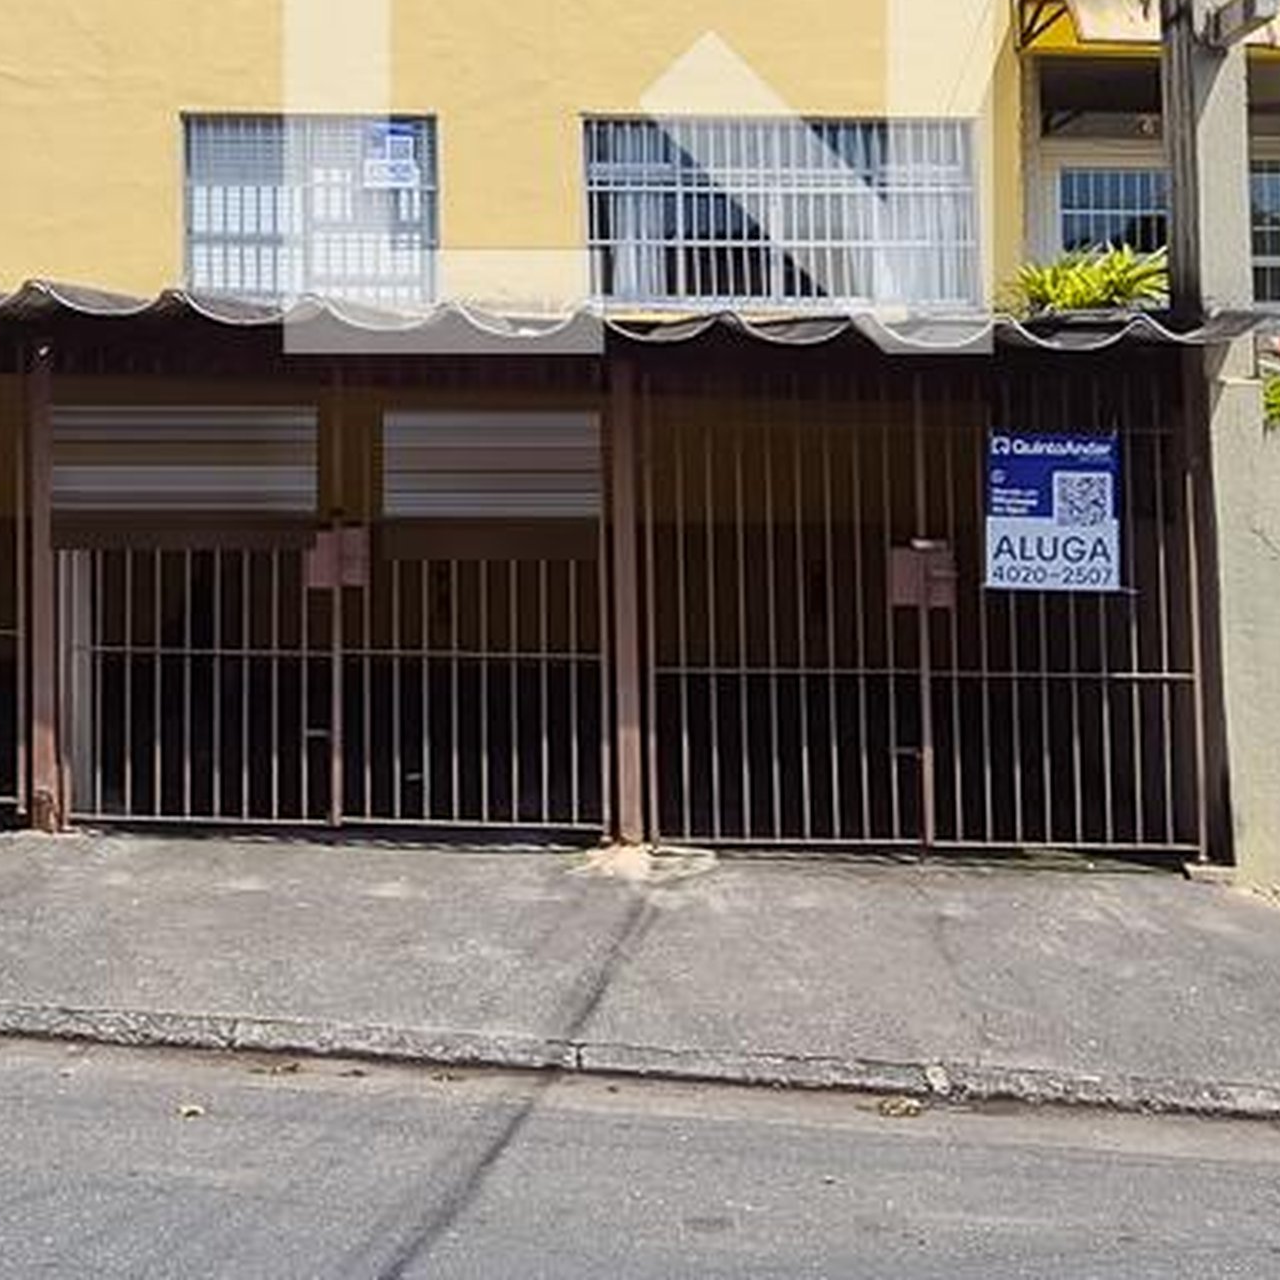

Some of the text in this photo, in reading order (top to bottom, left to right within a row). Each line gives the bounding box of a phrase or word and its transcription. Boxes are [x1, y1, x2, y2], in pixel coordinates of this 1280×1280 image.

[1012, 439, 1111, 455] QuintoAndar
[993, 535, 1111, 563] ALUGA
[992, 566, 1113, 585] 4020-2507
